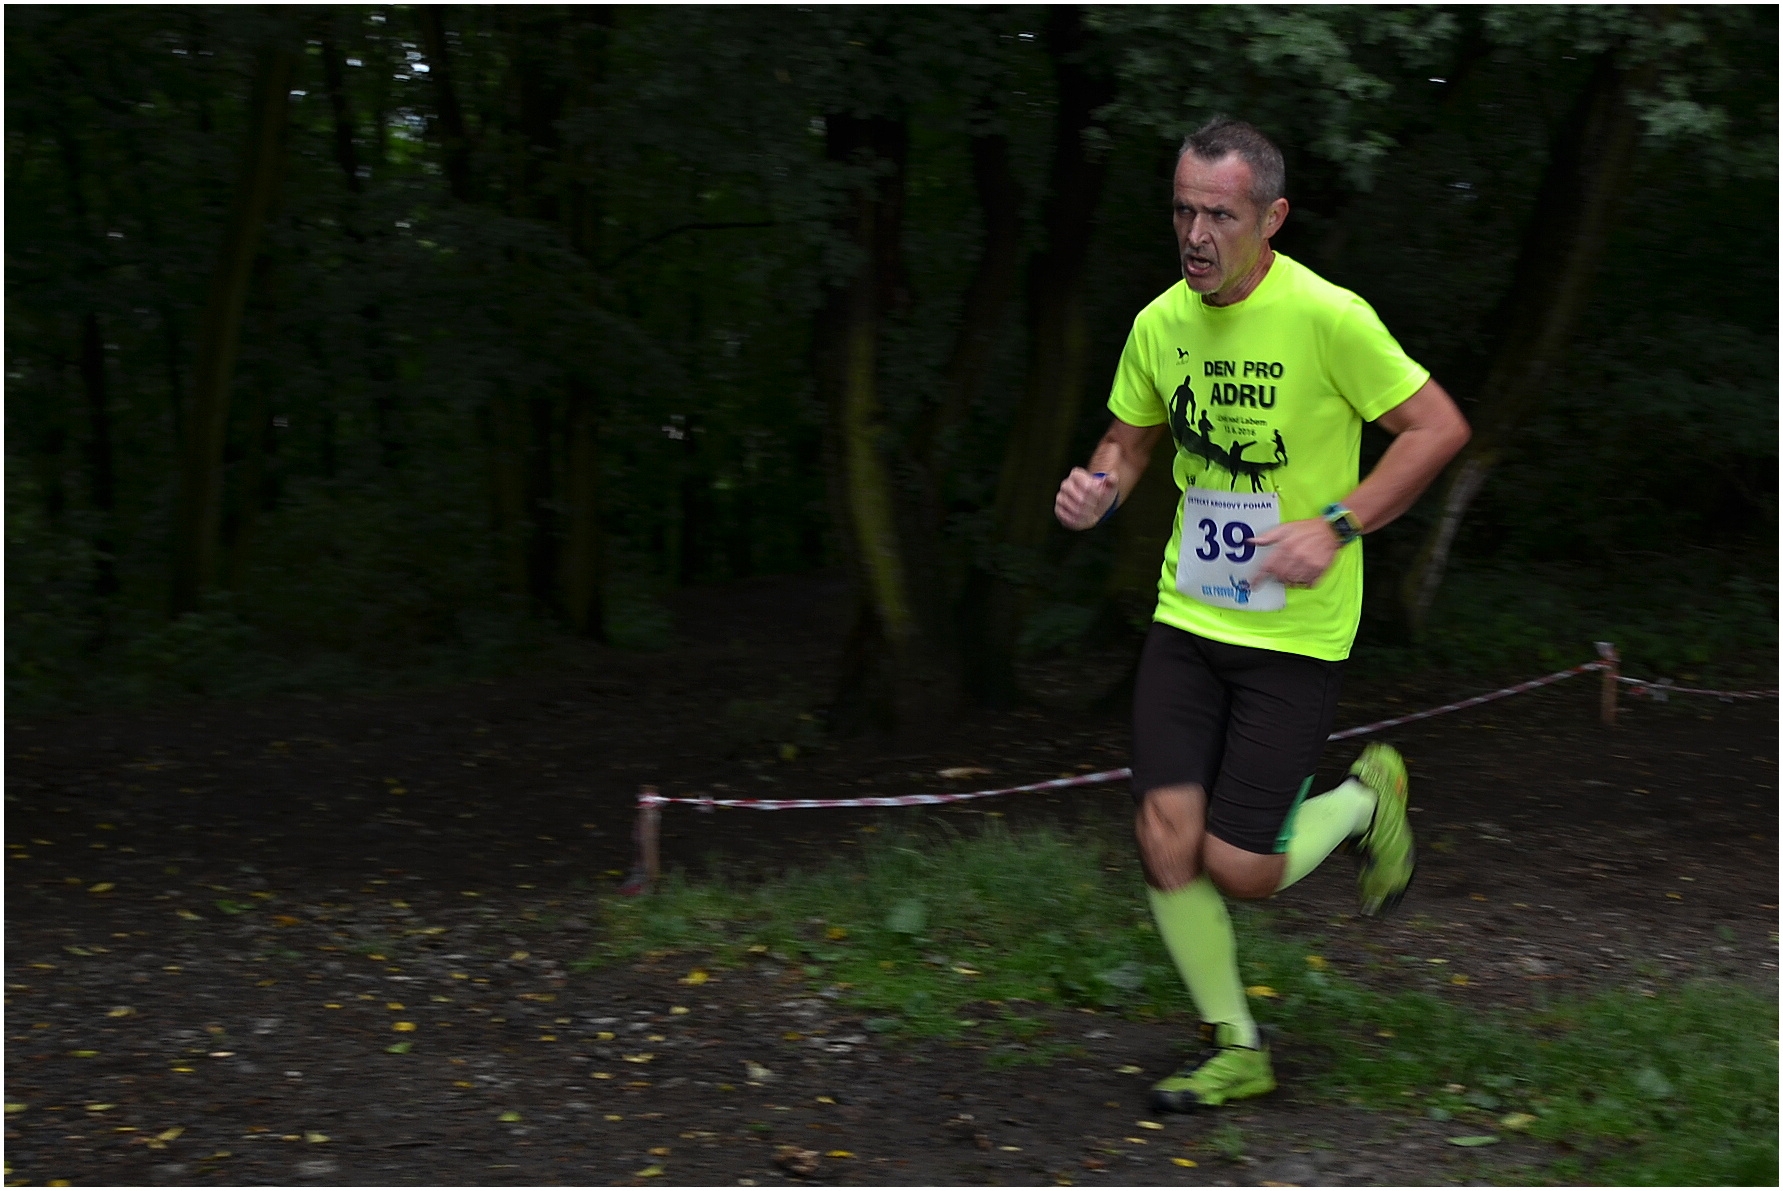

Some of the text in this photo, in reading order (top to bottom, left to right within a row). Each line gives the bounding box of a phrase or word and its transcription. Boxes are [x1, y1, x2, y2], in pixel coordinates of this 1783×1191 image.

[1204, 361, 1284, 378] DEN PRO
[1210, 382, 1276, 409] ADRU
[1196, 518, 1256, 563] 39
